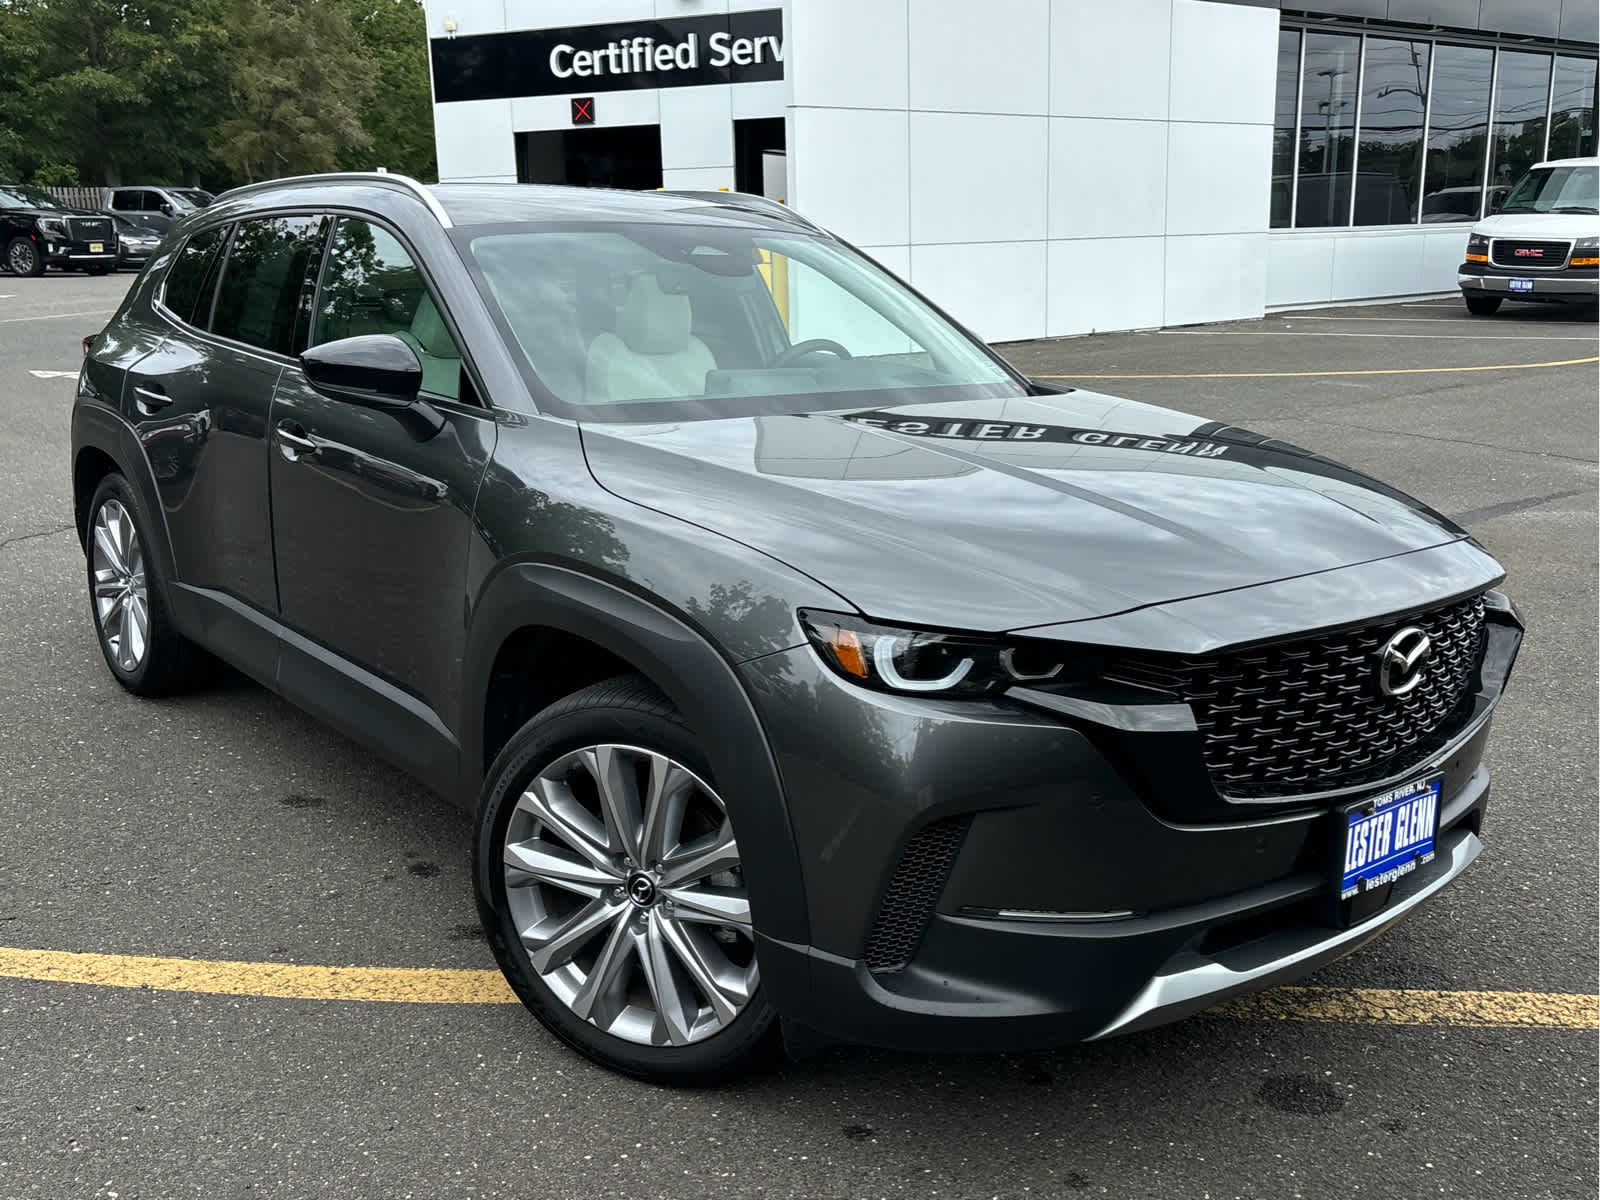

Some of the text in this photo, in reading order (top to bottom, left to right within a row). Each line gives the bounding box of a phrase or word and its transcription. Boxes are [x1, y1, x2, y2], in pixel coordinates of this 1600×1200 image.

[550, 33, 697, 78] Certified
[1514, 248, 1544, 257] GMC
[1373, 792, 1393, 808] TOMS
[1344, 794, 1438, 873] LESTER GLENN
